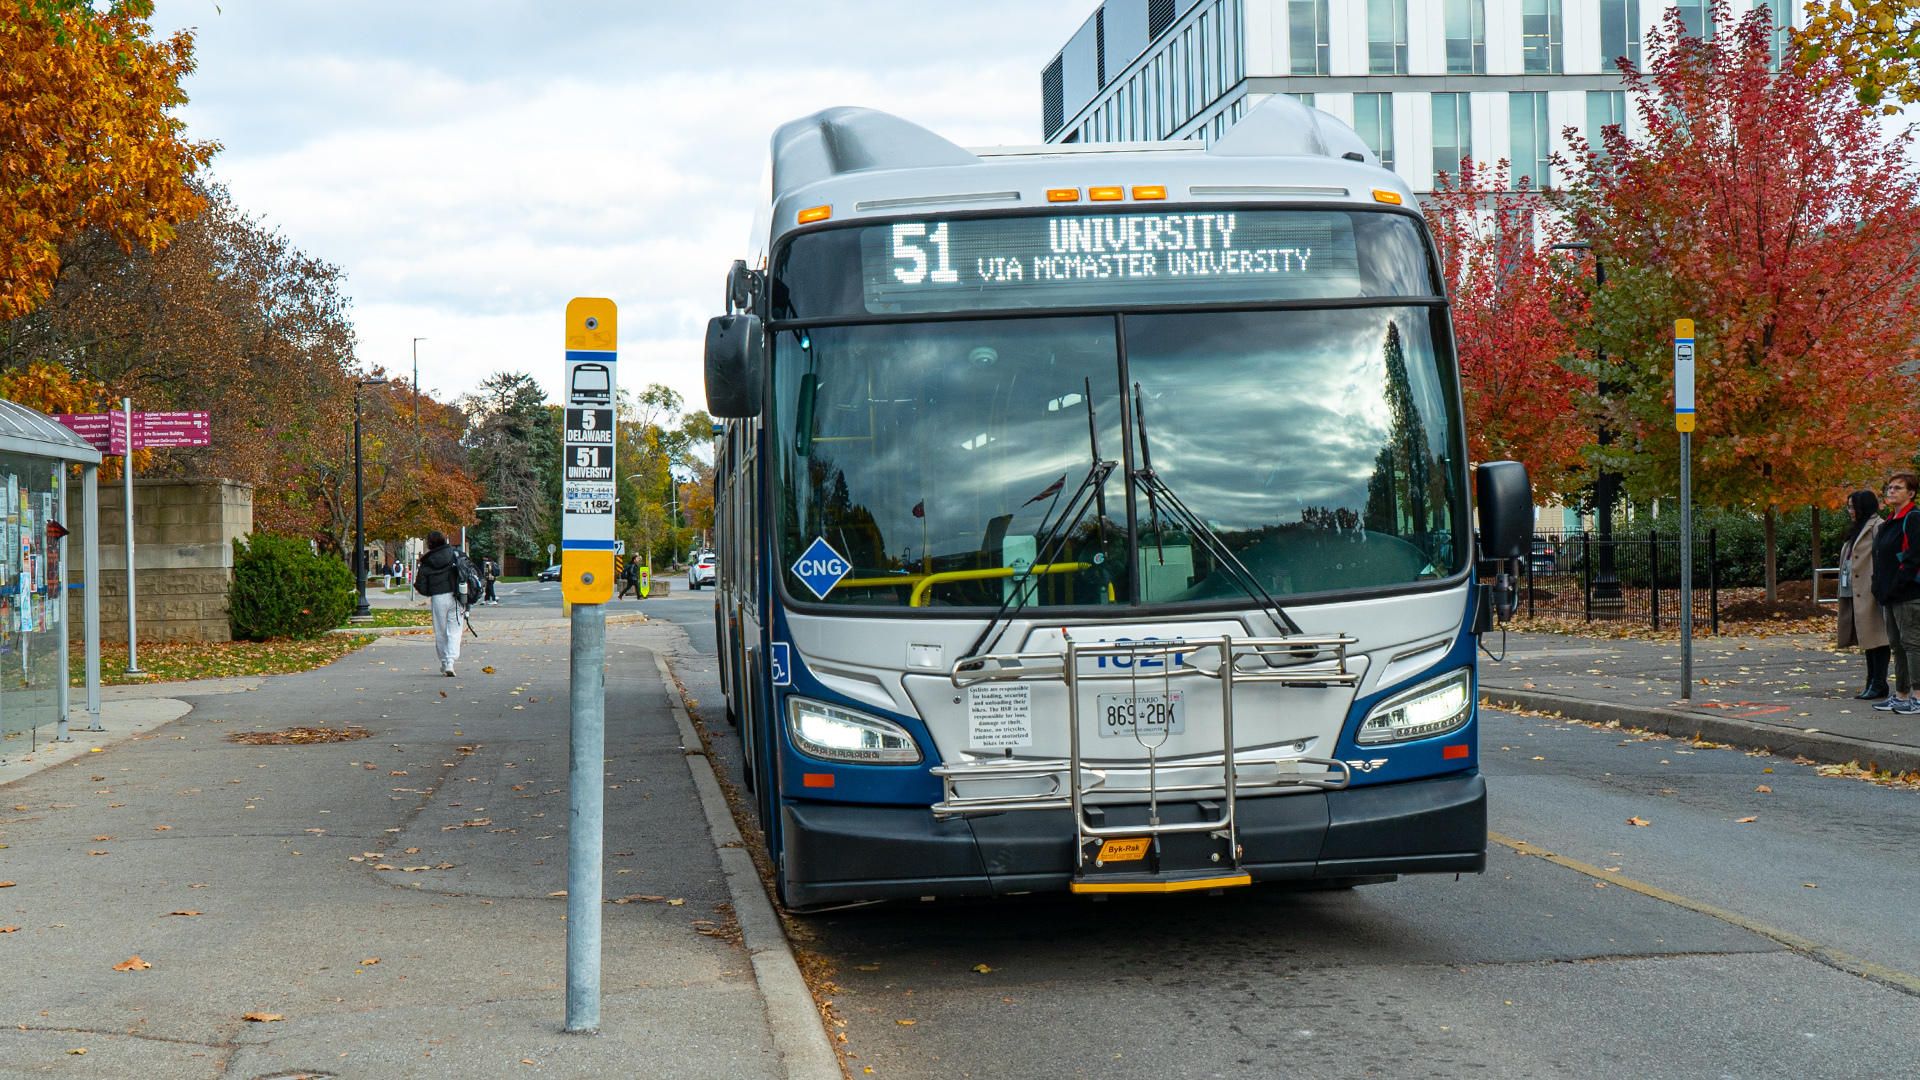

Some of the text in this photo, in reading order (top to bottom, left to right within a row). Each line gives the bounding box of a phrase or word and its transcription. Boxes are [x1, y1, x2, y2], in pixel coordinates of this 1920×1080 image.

[1049, 213, 1236, 252] UNIVERSITY
[892, 222, 957, 284] 51
[977, 248, 1311, 281] VIA MCMASTER UNIVERSITY
[582, 410, 595, 430] 5
[568, 430, 611, 442] DELAWARE
[577, 447, 598, 467] 51
[568, 467, 610, 478] UNIVERSITY
[799, 559, 841, 576] CNG
[1108, 703, 1175, 726] 869 2BK
[1109, 845, 1140, 854] Byk-Rak
